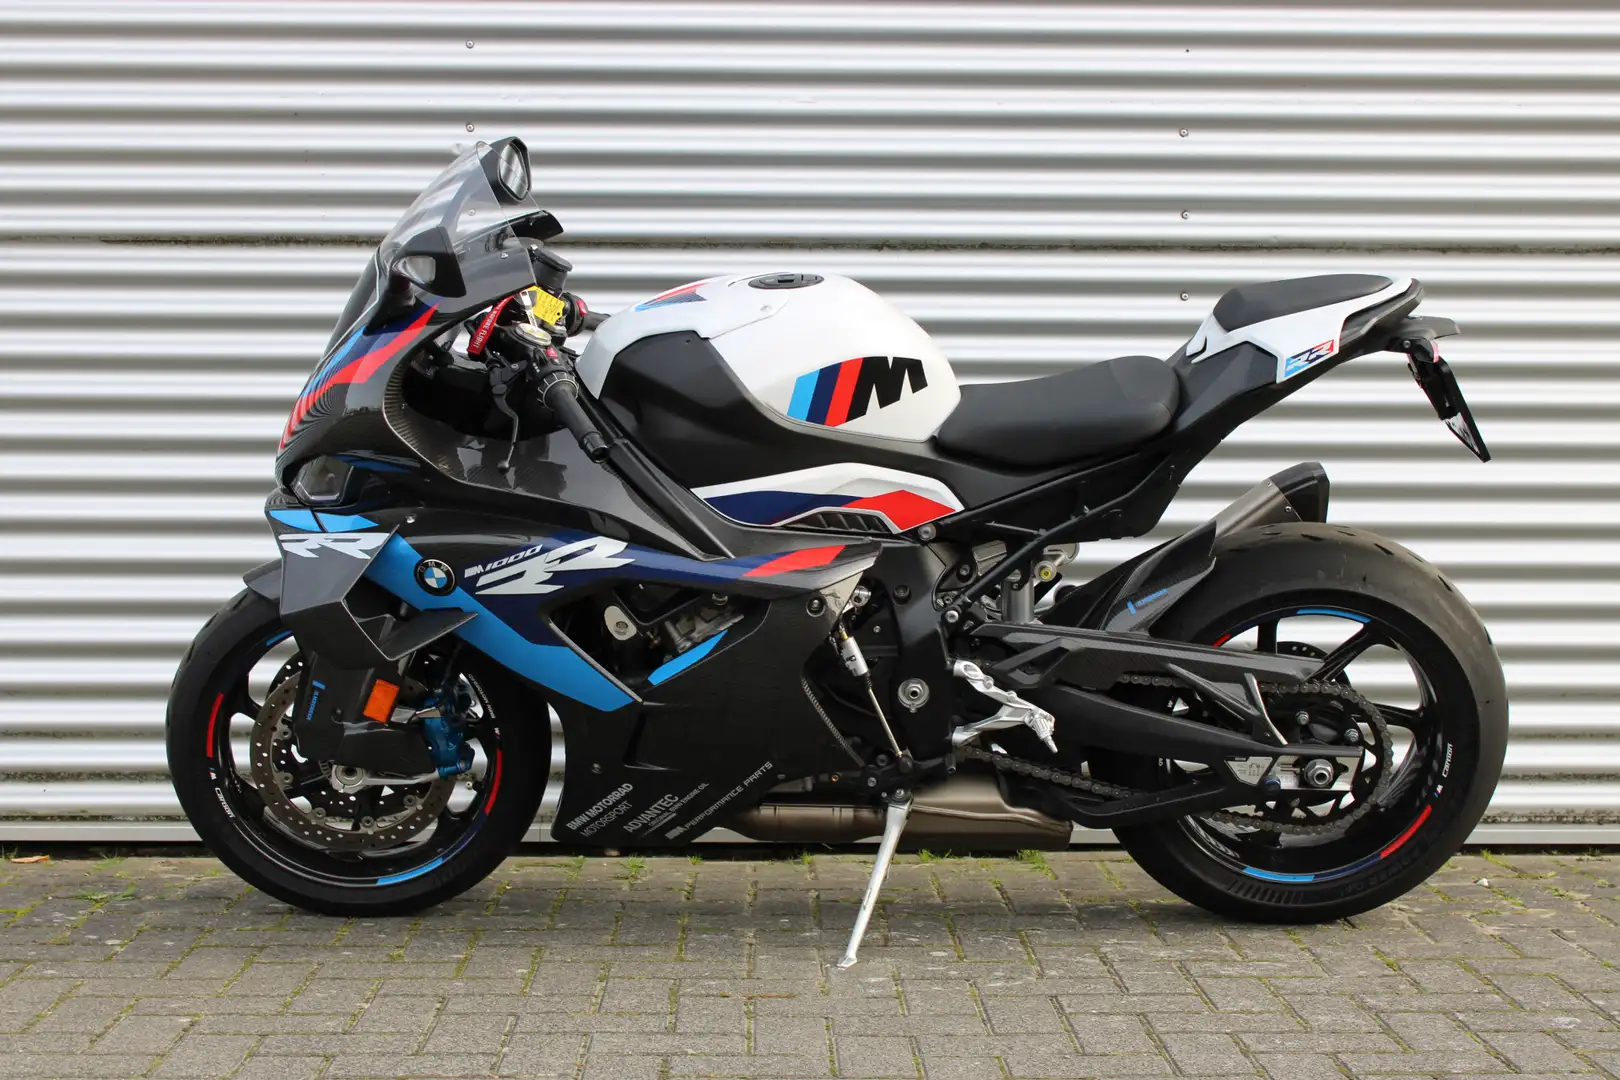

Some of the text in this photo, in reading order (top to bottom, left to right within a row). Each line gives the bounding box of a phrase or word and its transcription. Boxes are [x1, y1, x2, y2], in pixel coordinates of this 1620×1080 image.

[472, 329, 487, 348] FLIGHT
[845, 356, 928, 423] M
[475, 535, 636, 595] RR
[567, 783, 633, 830] BMW MOTORRAD
[622, 794, 679, 833] ADVANTEC
[684, 785, 743, 829] PERFORMANCE
[743, 761, 773, 787] PARTS
[580, 800, 633, 838] MOTORSPORT
